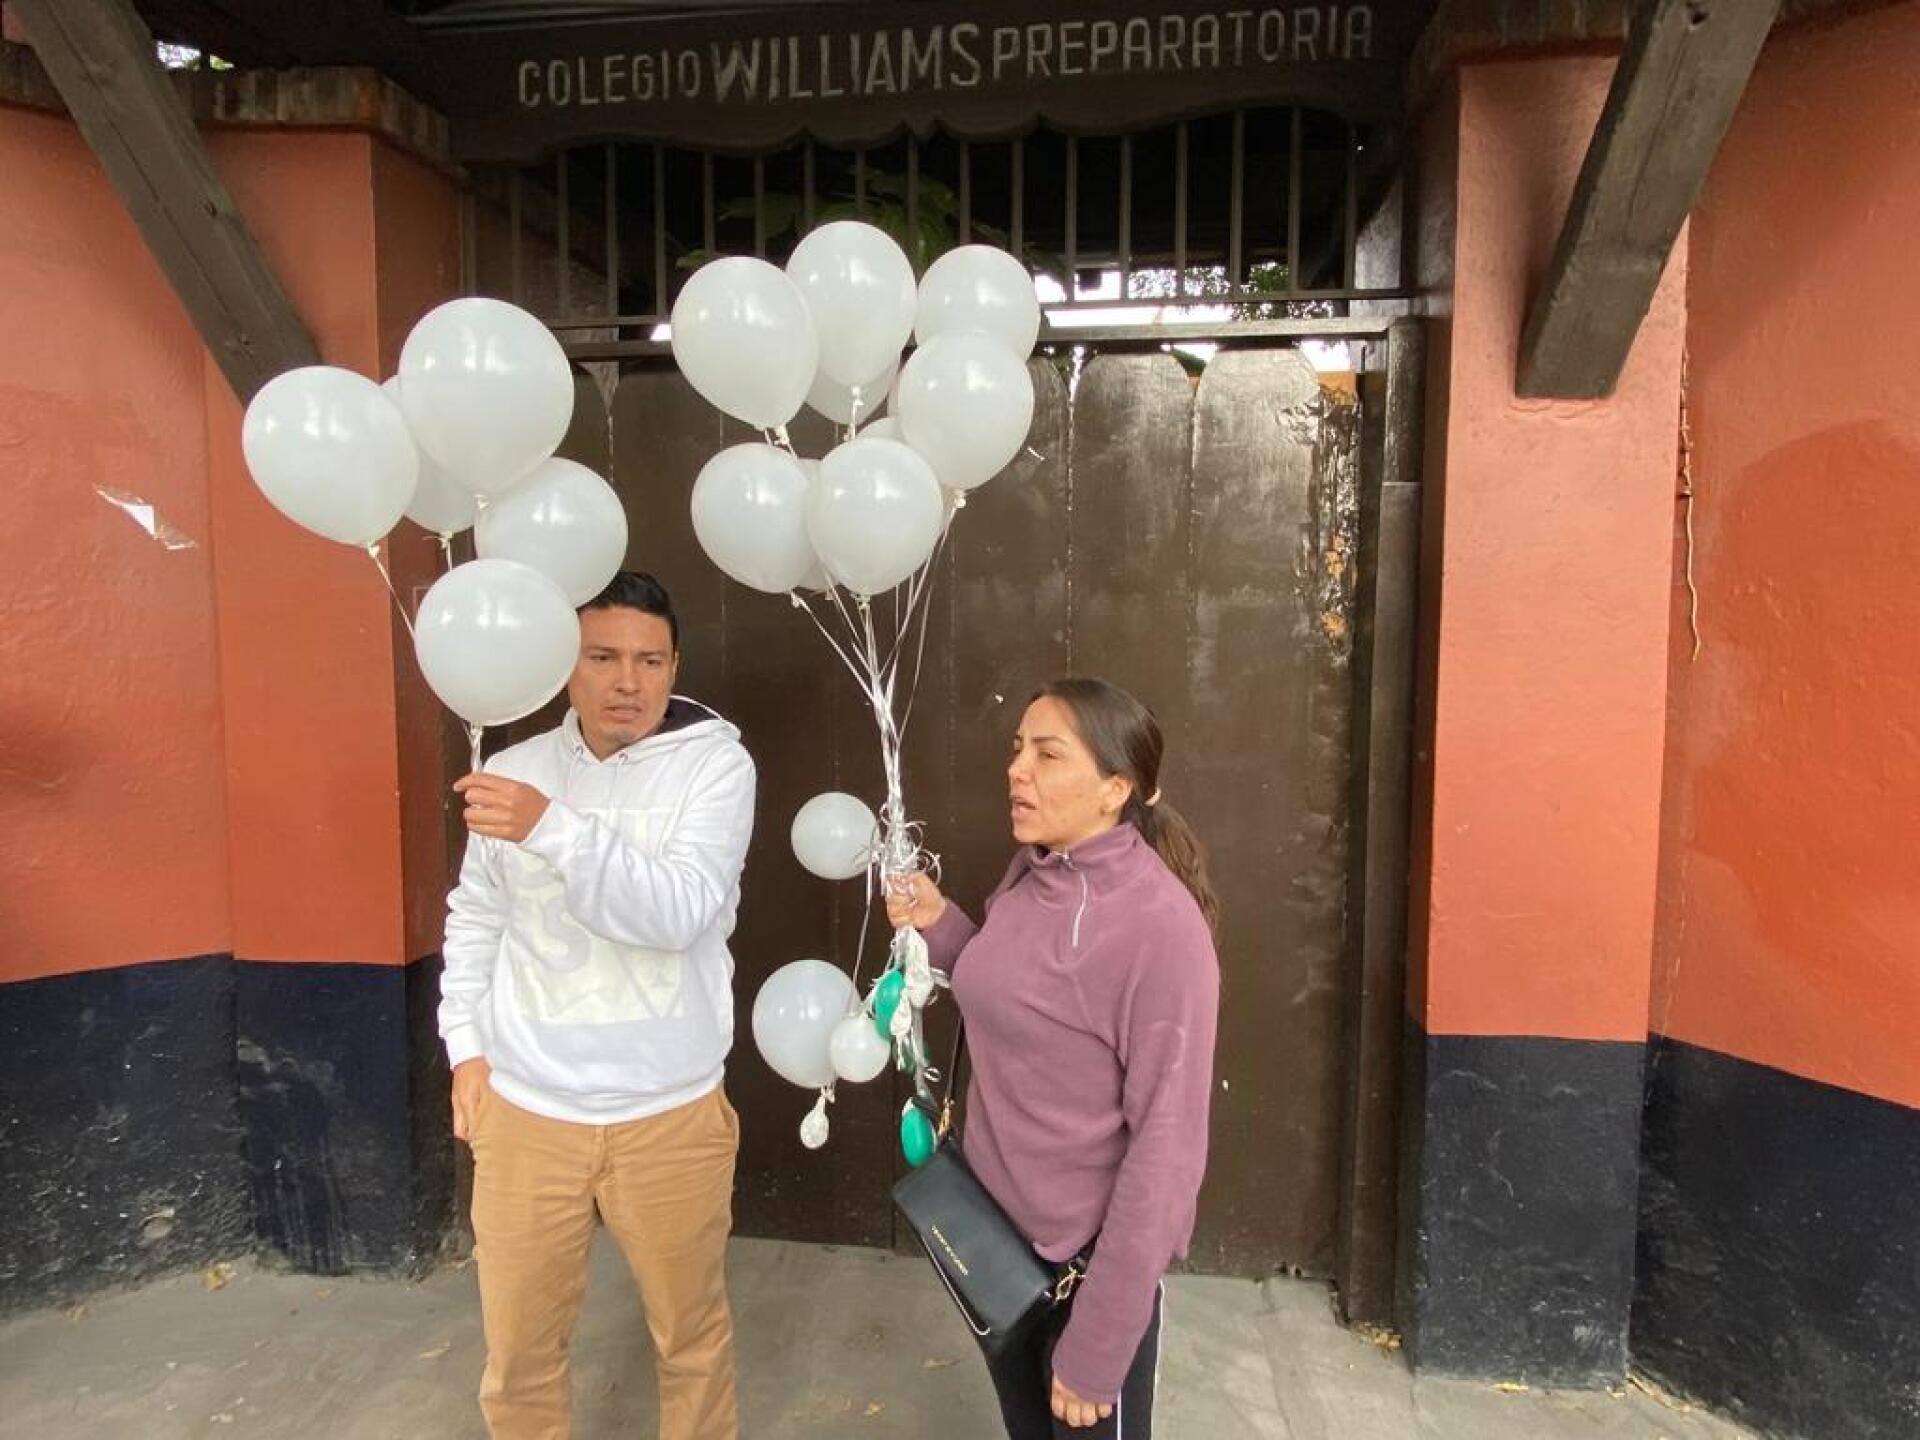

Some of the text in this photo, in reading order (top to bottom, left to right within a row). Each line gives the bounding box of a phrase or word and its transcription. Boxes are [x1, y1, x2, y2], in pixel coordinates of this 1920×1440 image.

[518, 5, 1373, 108] COLEGIO WILLIAMS PREPARATORIA
